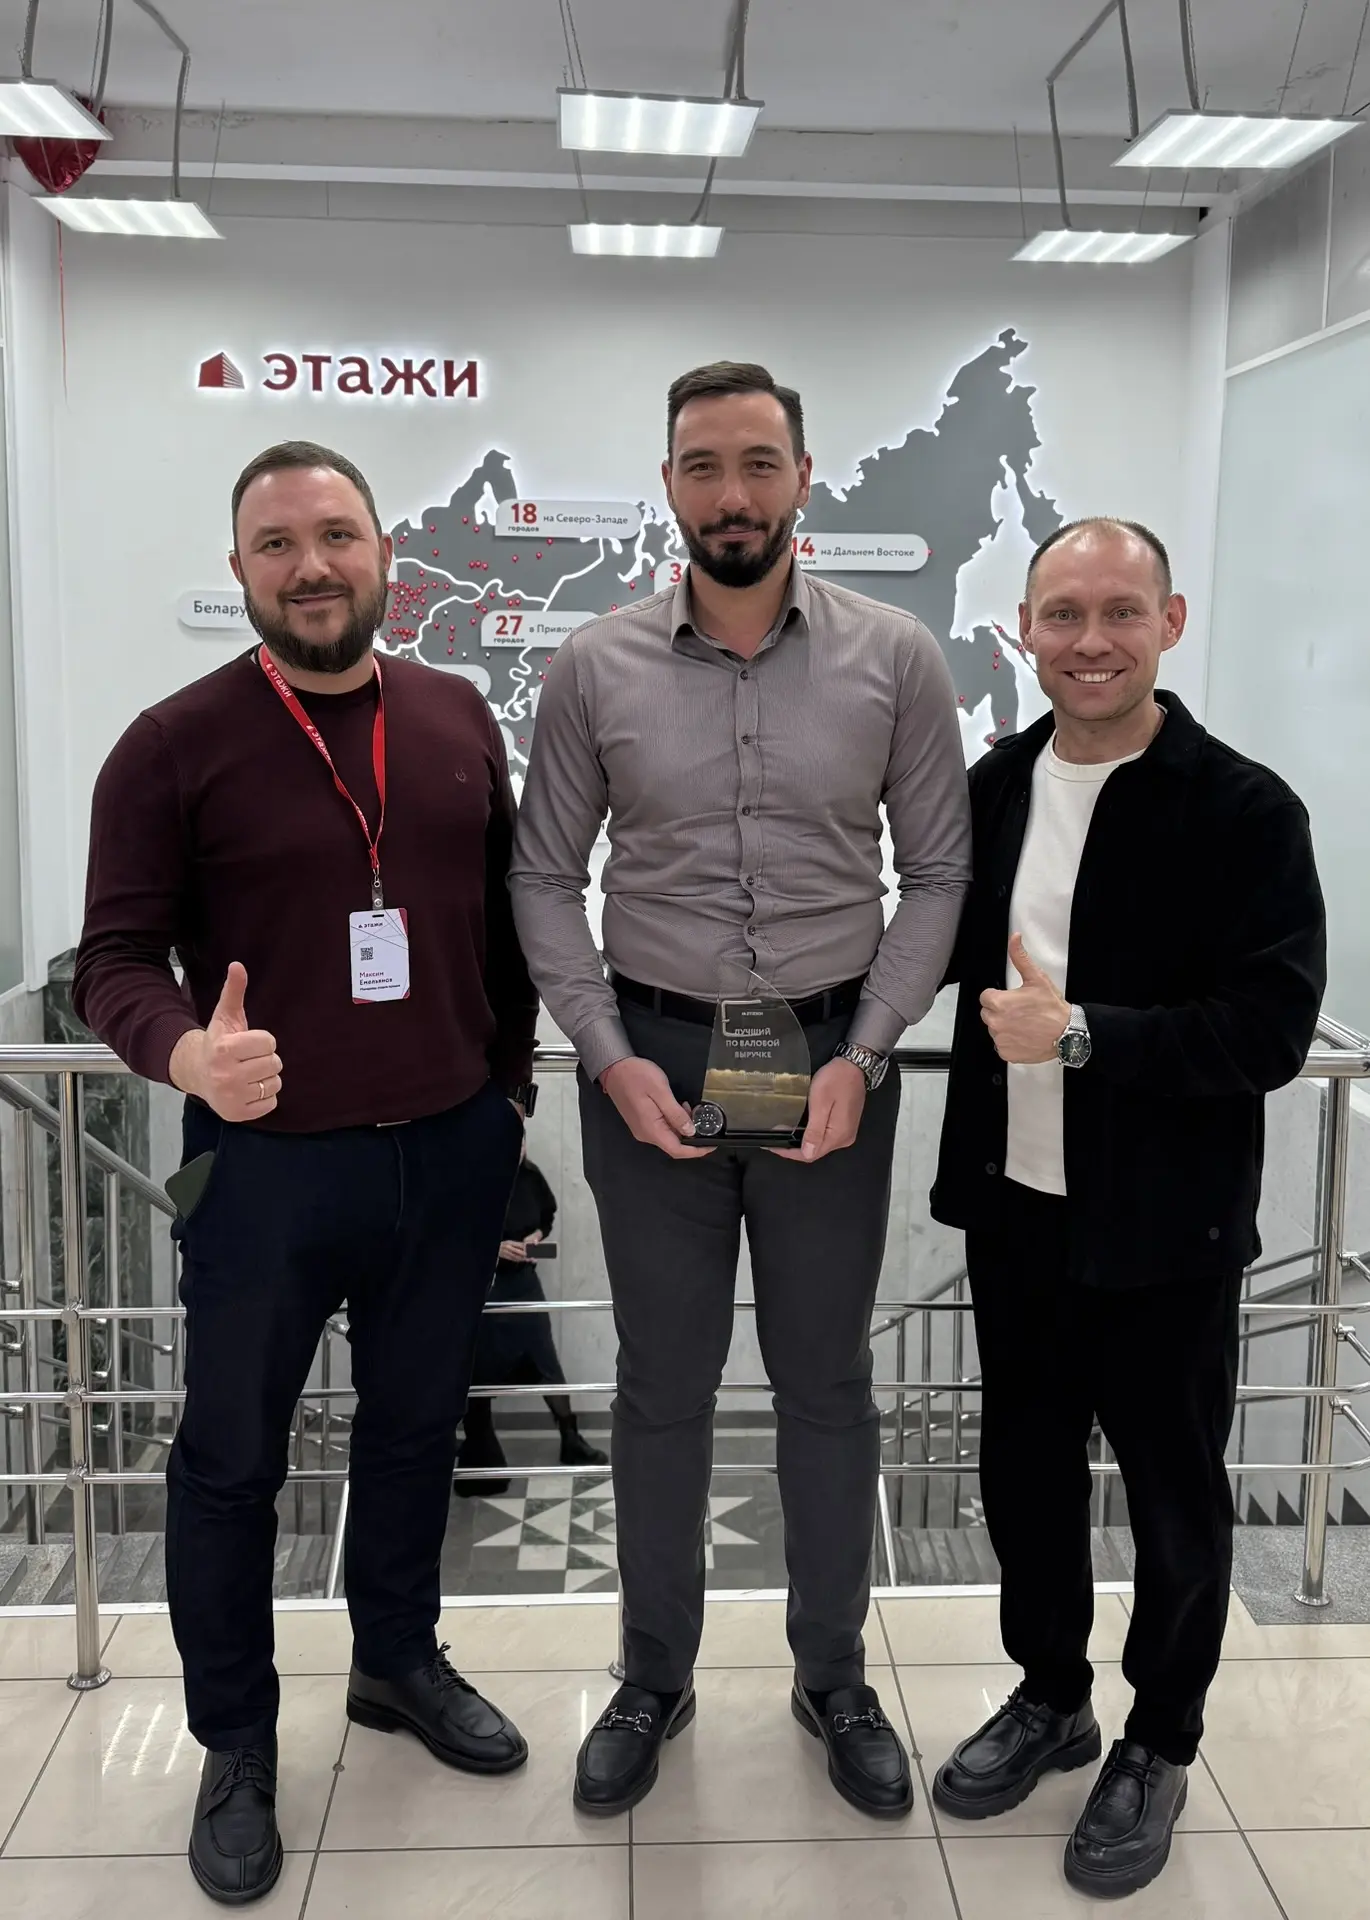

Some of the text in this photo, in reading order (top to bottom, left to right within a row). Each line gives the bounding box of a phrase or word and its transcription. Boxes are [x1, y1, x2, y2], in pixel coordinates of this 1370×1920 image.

[262, 353, 478, 398] этажи
[511, 503, 628, 525] 18 на Северо-Западе
[792, 536, 815, 557] 14
[833, 547, 875, 557] Дальнем
[876, 547, 915, 557] Востоке
[193, 600, 246, 617] Белару
[495, 615, 523, 635] 27
[536, 624, 573, 635] Привол
[734, 1027, 771, 1036] ЛУЧШИЙ
[725, 1038, 780, 1047] ПО ВАЛОВОЙ
